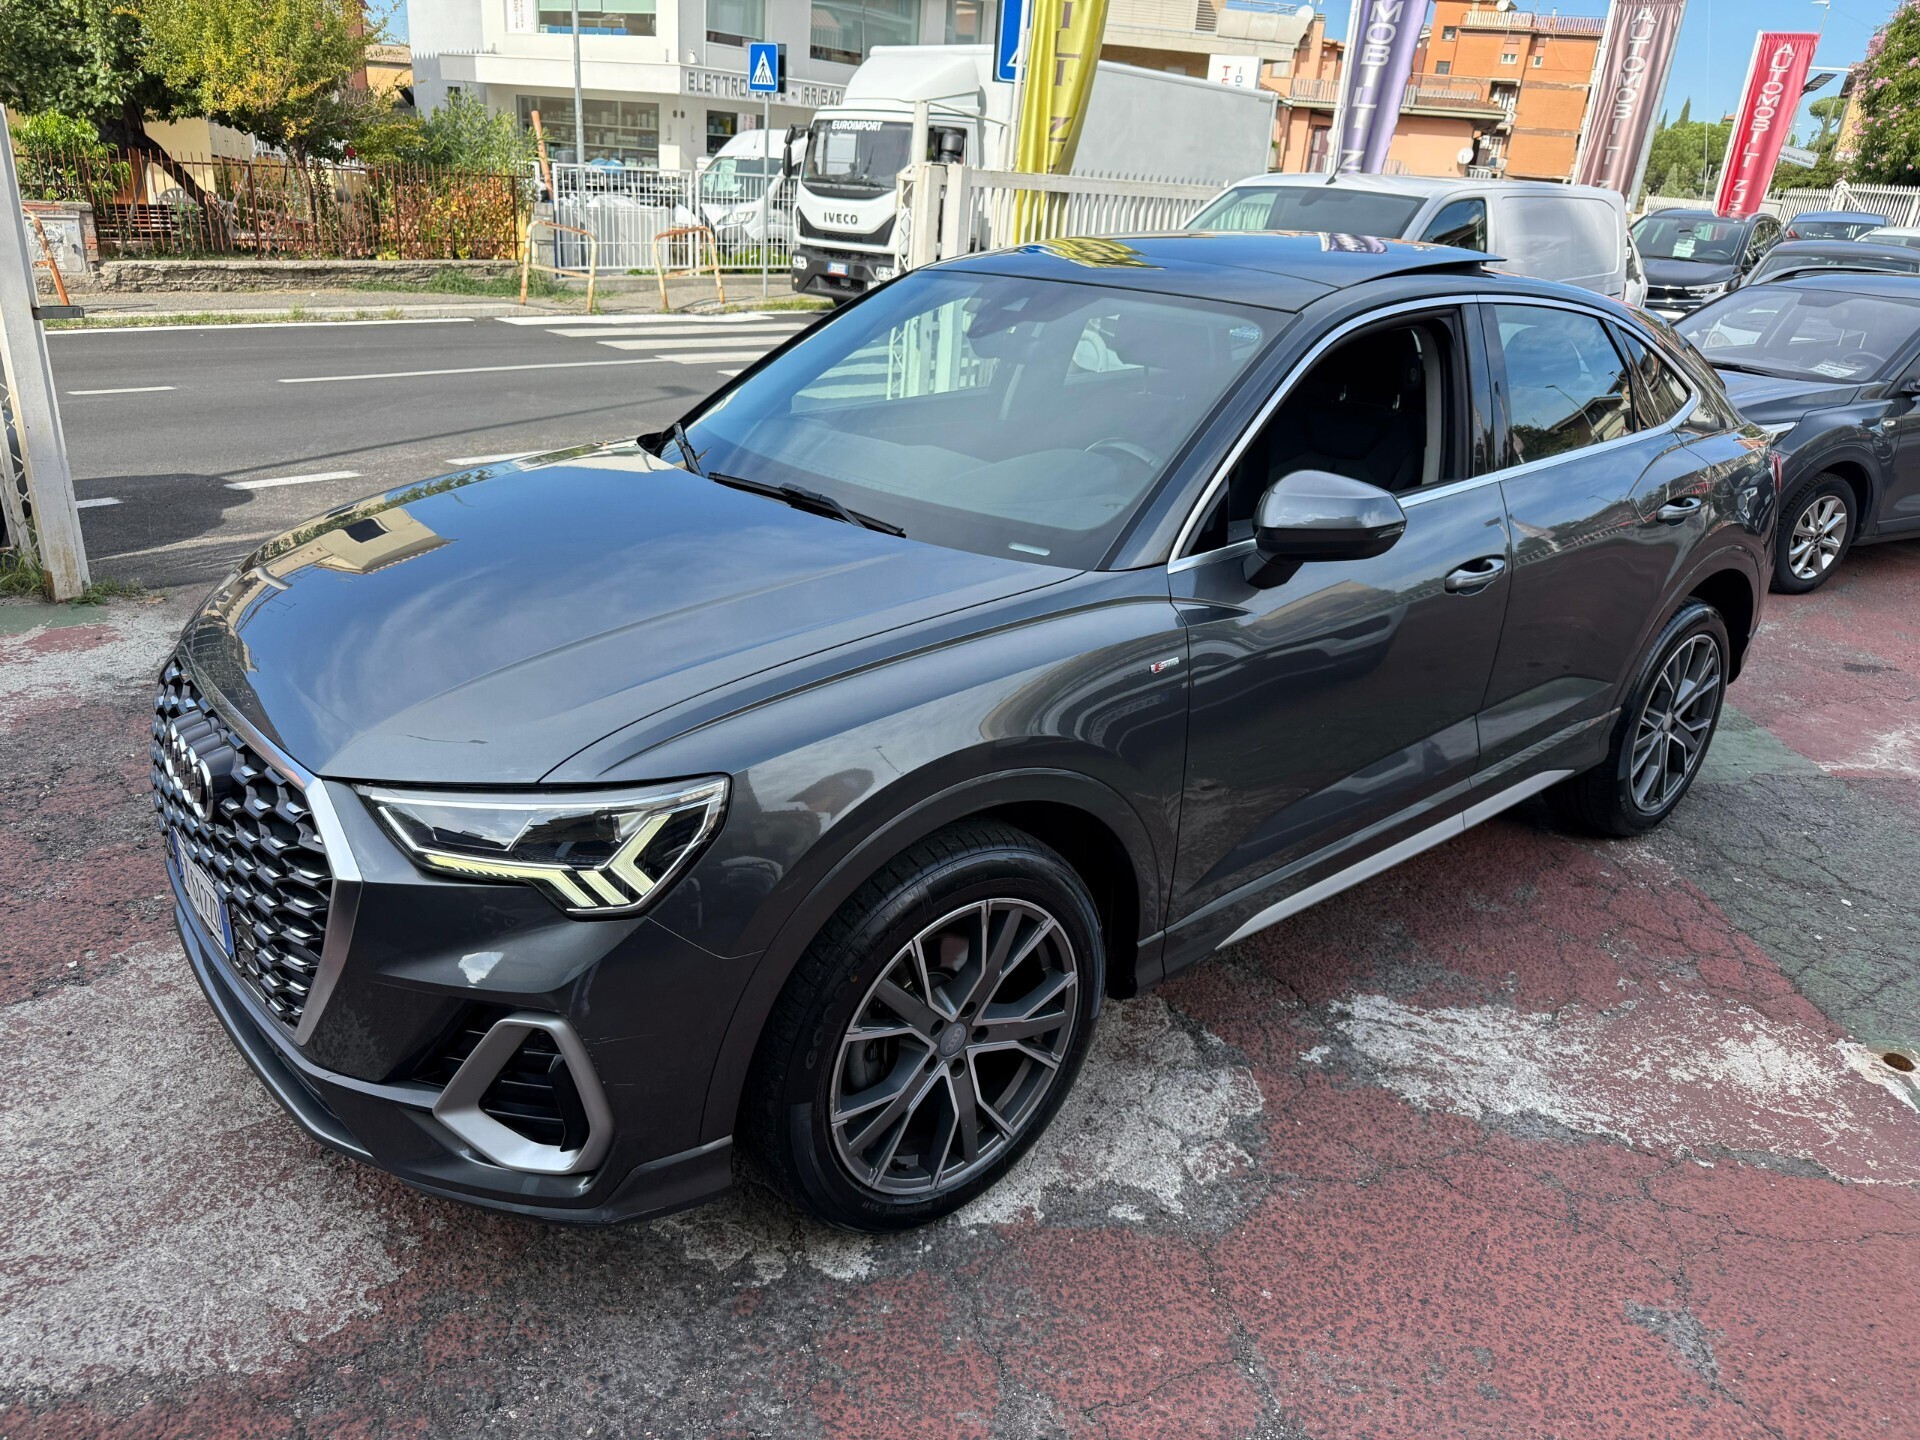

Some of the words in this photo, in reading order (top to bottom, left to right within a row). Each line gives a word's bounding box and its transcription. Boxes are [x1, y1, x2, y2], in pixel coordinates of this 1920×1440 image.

[1603, 7, 1657, 165] AUTOMOBILI
[1742, 43, 1795, 168] AUTOMOBILI
[832, 120, 883, 131] EUROIMPORT
[824, 212, 858, 225] IVECO
